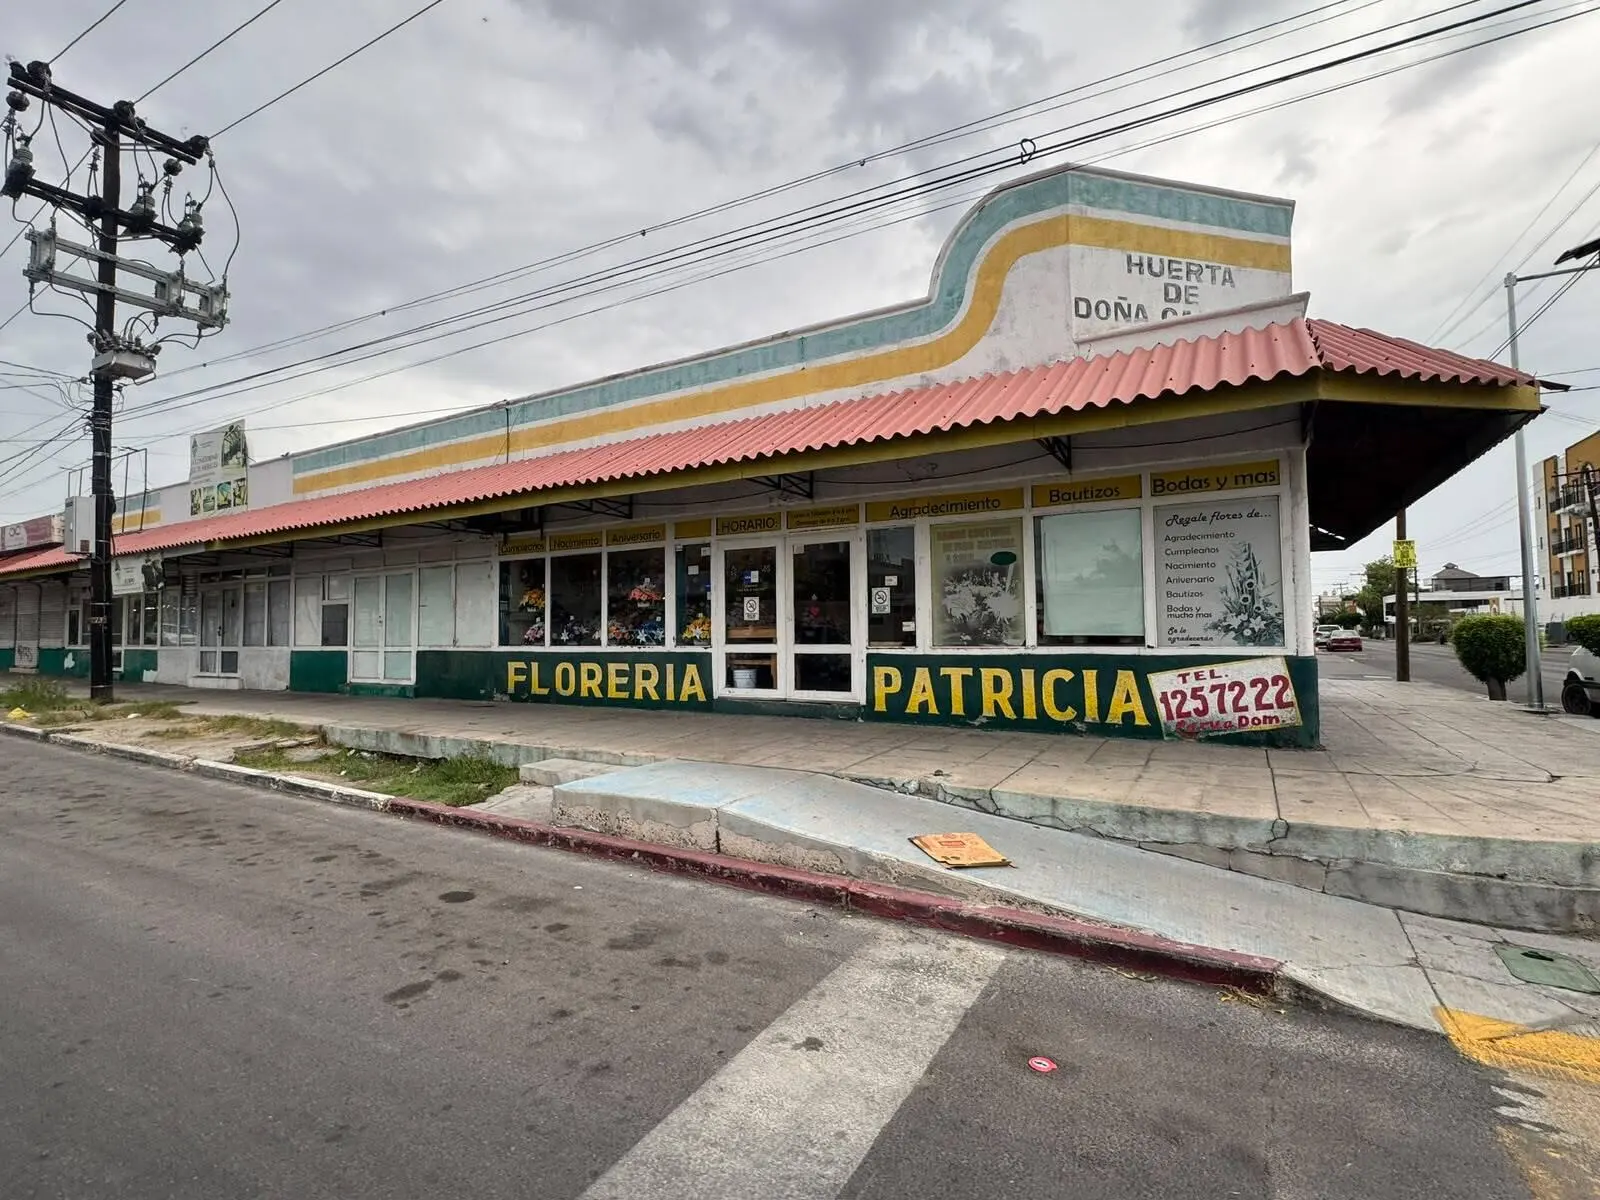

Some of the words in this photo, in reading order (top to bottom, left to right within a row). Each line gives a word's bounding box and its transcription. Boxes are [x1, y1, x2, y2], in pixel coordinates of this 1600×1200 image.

[1126, 253, 1235, 288] HUERTA
[1163, 282, 1199, 305] DE
[1074, 295, 1149, 323] DOÑA
[1152, 475, 1210, 494] Bodas
[1216, 474, 1228, 491] y
[1234, 470, 1276, 486] mas
[1050, 484, 1121, 503] Bautizos
[889, 498, 1001, 519] Agradecimiento
[1165, 511, 1208, 527] Regale
[1209, 510, 1243, 525] flores
[1164, 531, 1235, 543] Agradecimiento
[1165, 560, 1217, 571] Nacimiento
[1165, 575, 1215, 585] Aniversario
[1166, 590, 1204, 599] Bautizos
[1166, 604, 1194, 613] Bodas
[506, 661, 707, 702] FLORERIA
[1175, 669, 1230, 685] TEL.
[873, 666, 1152, 727] PATRICIA
[1159, 674, 1295, 722] 1257222
